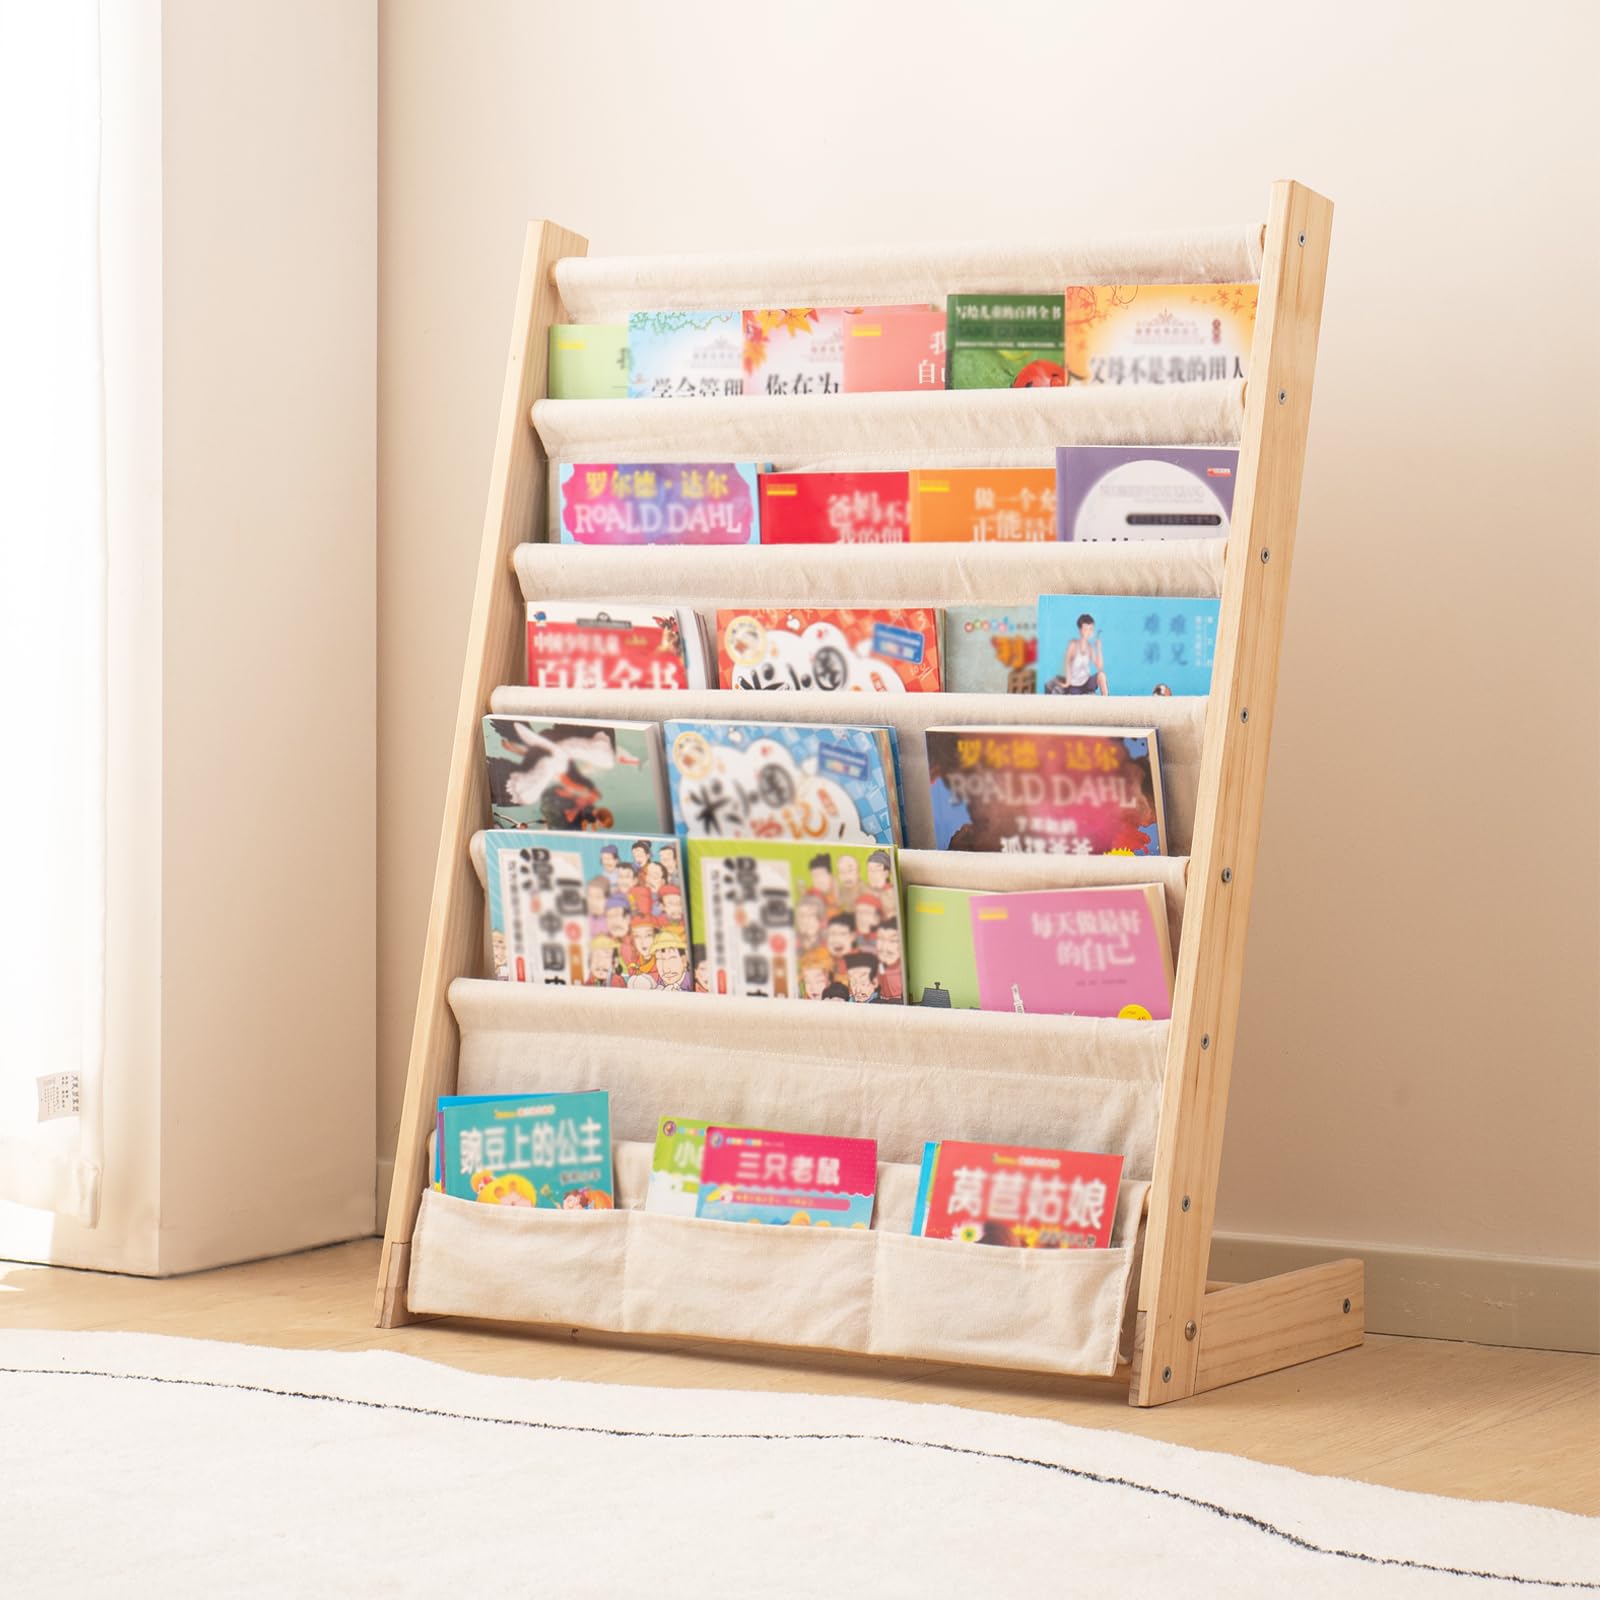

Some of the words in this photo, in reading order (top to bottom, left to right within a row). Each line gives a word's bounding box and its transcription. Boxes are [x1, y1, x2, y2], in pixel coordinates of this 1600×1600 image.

[918, 358, 947, 385] 自
[574, 503, 664, 533] ROALD
[668, 504, 742, 534] DAHL
[949, 770, 1045, 805] ROALD
[1051, 776, 1137, 808] DAHL
[736, 1152, 841, 1187] 三只老鼠
[947, 1165, 1107, 1229] 莴苣姑娘
